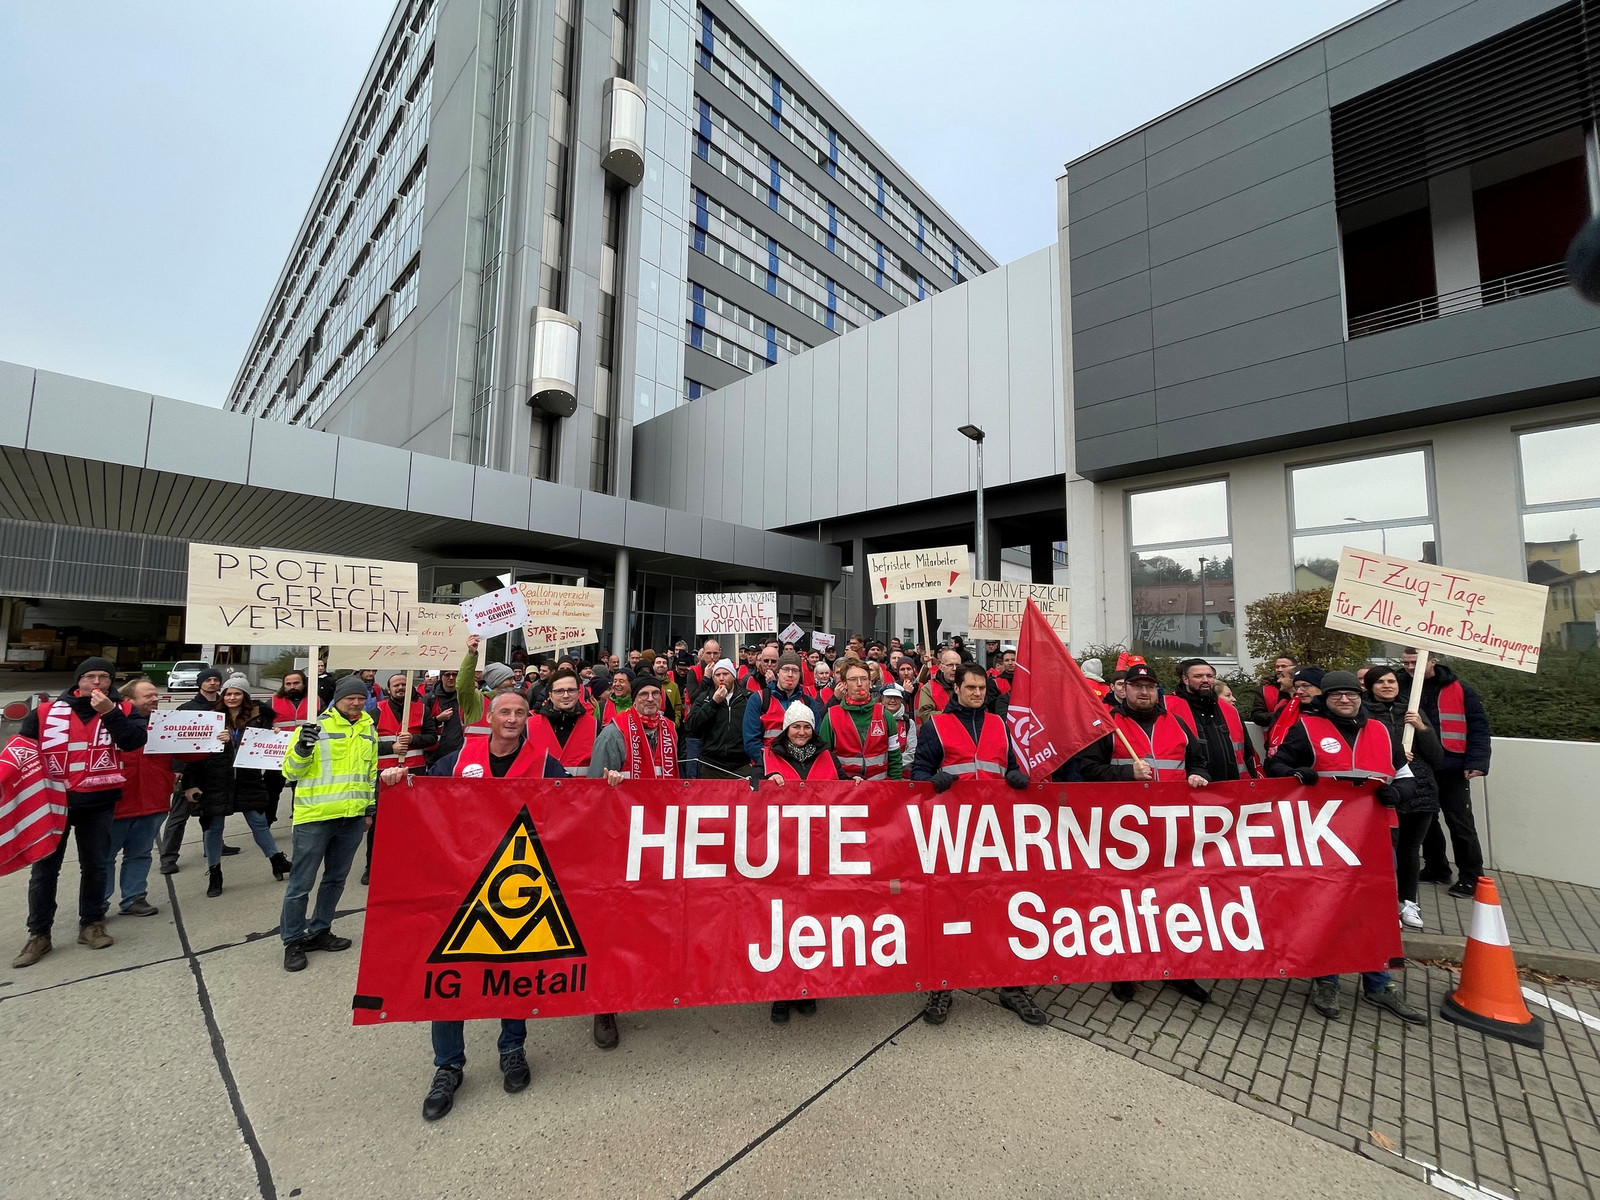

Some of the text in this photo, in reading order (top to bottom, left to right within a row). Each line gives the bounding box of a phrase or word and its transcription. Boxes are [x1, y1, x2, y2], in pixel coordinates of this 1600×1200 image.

[214, 552, 383, 586] PROFITE
[872, 553, 958, 574] befristete Mitarbeiter
[519, 583, 590, 599] Reallohnverzicht
[900, 574, 941, 591] übernehmen
[972, 582, 1070, 602] LOHNVERZICHT
[256, 583, 409, 611] GERECHT
[697, 593, 729, 606] BESSER
[729, 593, 743, 604] ALS
[980, 599, 1021, 613] RETTET
[475, 601, 514, 619] SOLIDARITÄT
[488, 607, 516, 621] GEWINNT
[711, 602, 764, 620] SOZIALE
[219, 604, 411, 637] VERTEILEN!
[703, 617, 773, 633] KOMPONENTE
[1336, 591, 1362, 617] für
[1417, 611, 1454, 637] ohne
[1458, 620, 1540, 665] Bedingungen
[625, 799, 1361, 881] HEUTE WARNSTREIK
[748, 899, 907, 973] Jena
[1008, 886, 1264, 961] Saalfeld
[424, 964, 587, 1000] IG Metall
